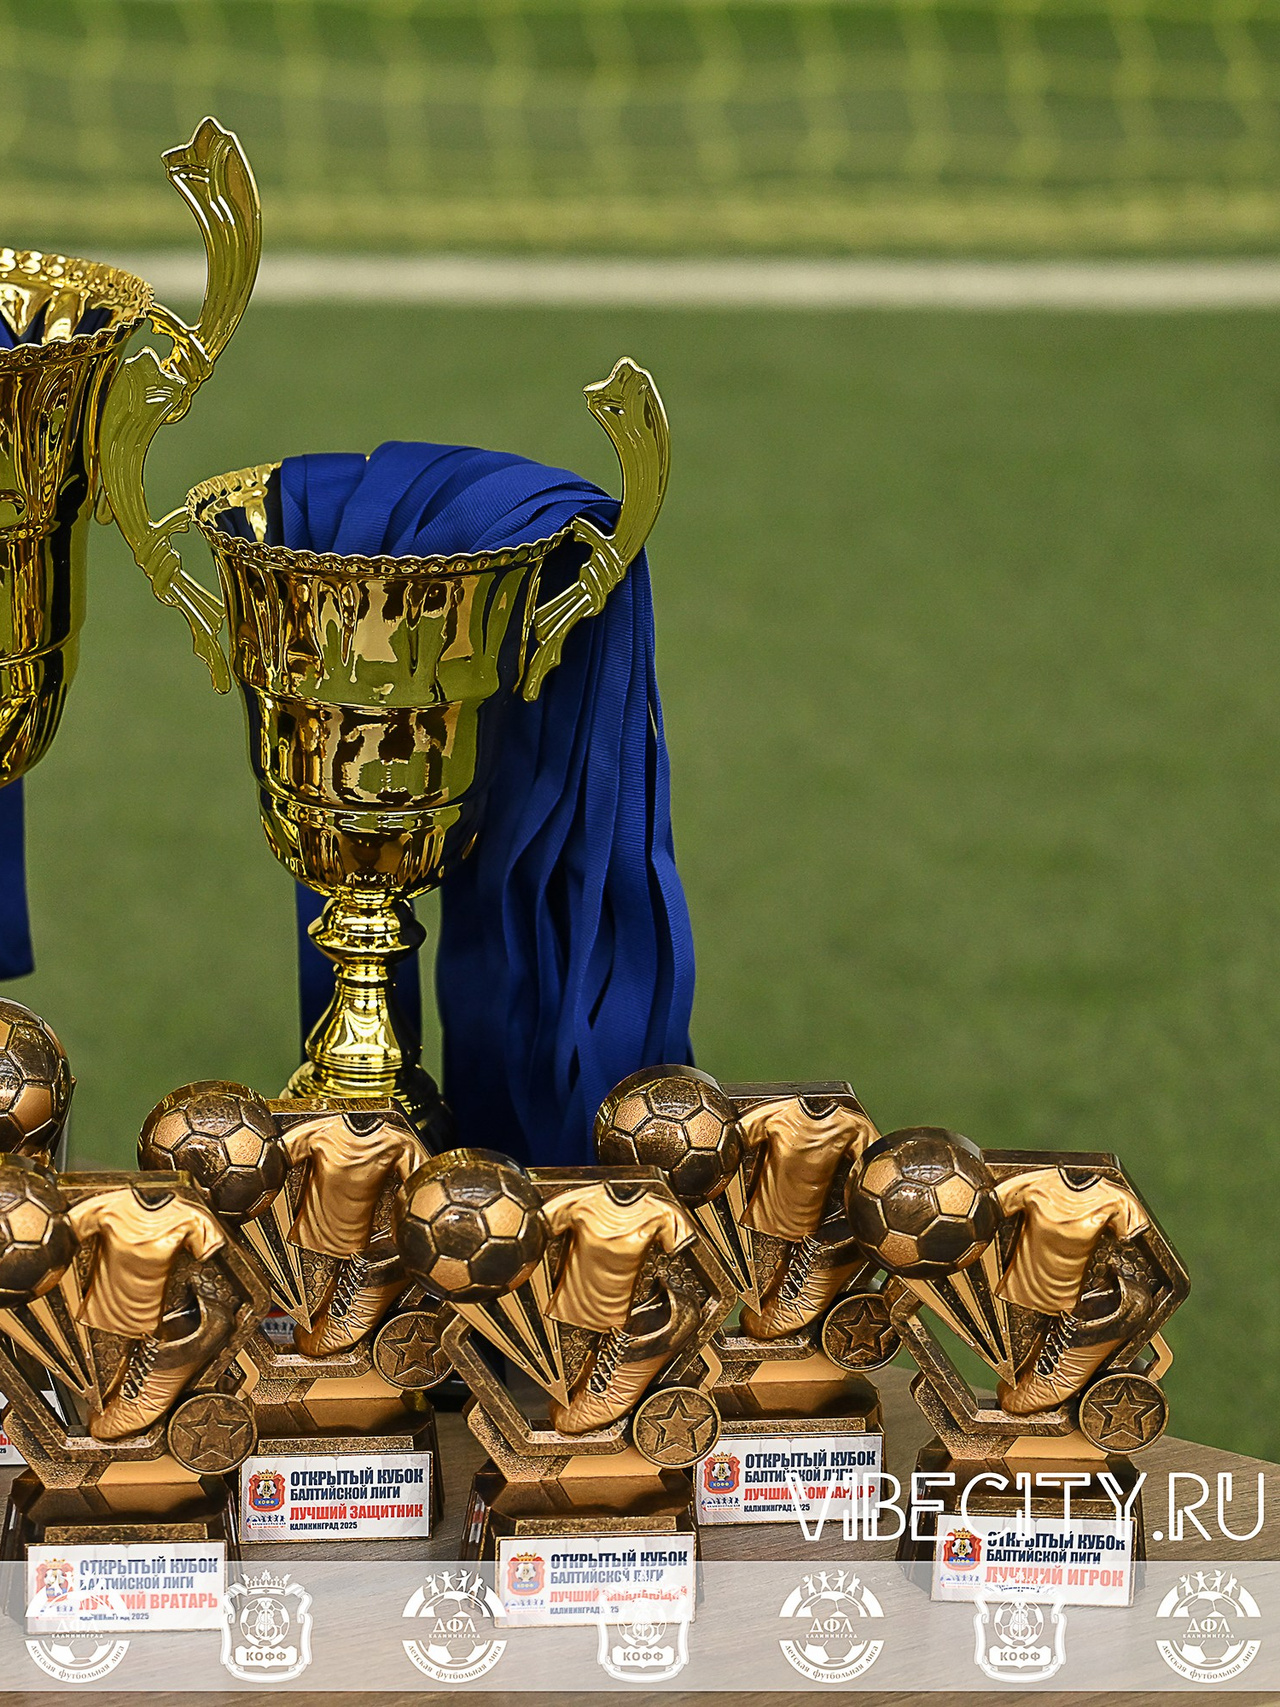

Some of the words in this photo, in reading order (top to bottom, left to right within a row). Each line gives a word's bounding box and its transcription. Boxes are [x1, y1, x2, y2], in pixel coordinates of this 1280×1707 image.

[745, 1450, 826, 1469] ОТКРЫТЫЙ
[831, 1451, 876, 1466] КУБОК
[291, 1467, 373, 1486] ОТКРЫТЫЙ
[377, 1468, 423, 1484] КУБОК
[290, 1485, 367, 1501] БАЛТИЙСКОЙ
[370, 1486, 400, 1499] ЛИГИ
[290, 1503, 347, 1520] ЛУЧШИЙ
[350, 1504, 423, 1520] ЗАЩИТНИК
[744, 1504, 792, 1512] КАЛИНИНГРАД
[290, 1522, 339, 1530] КАЛИНИНГРАД
[551, 1549, 636, 1568] ОТКРЫТЫЙ
[641, 1551, 687, 1566] КУБОК
[986, 1548, 1066, 1563] БАЛТИЙСКОЙ
[1070, 1552, 1101, 1564] ЛИГИ
[80, 1556, 166, 1574] ОТКРЫТЫЙ
[170, 1558, 218, 1573] КУБОК
[163, 1576, 193, 1589] ЛИГИ
[1067, 1569, 1124, 1587] ИГРОК
[150, 1593, 218, 1609] ВРАТАРЬ
[550, 1588, 600, 1602] ЛУЧШИЙ
